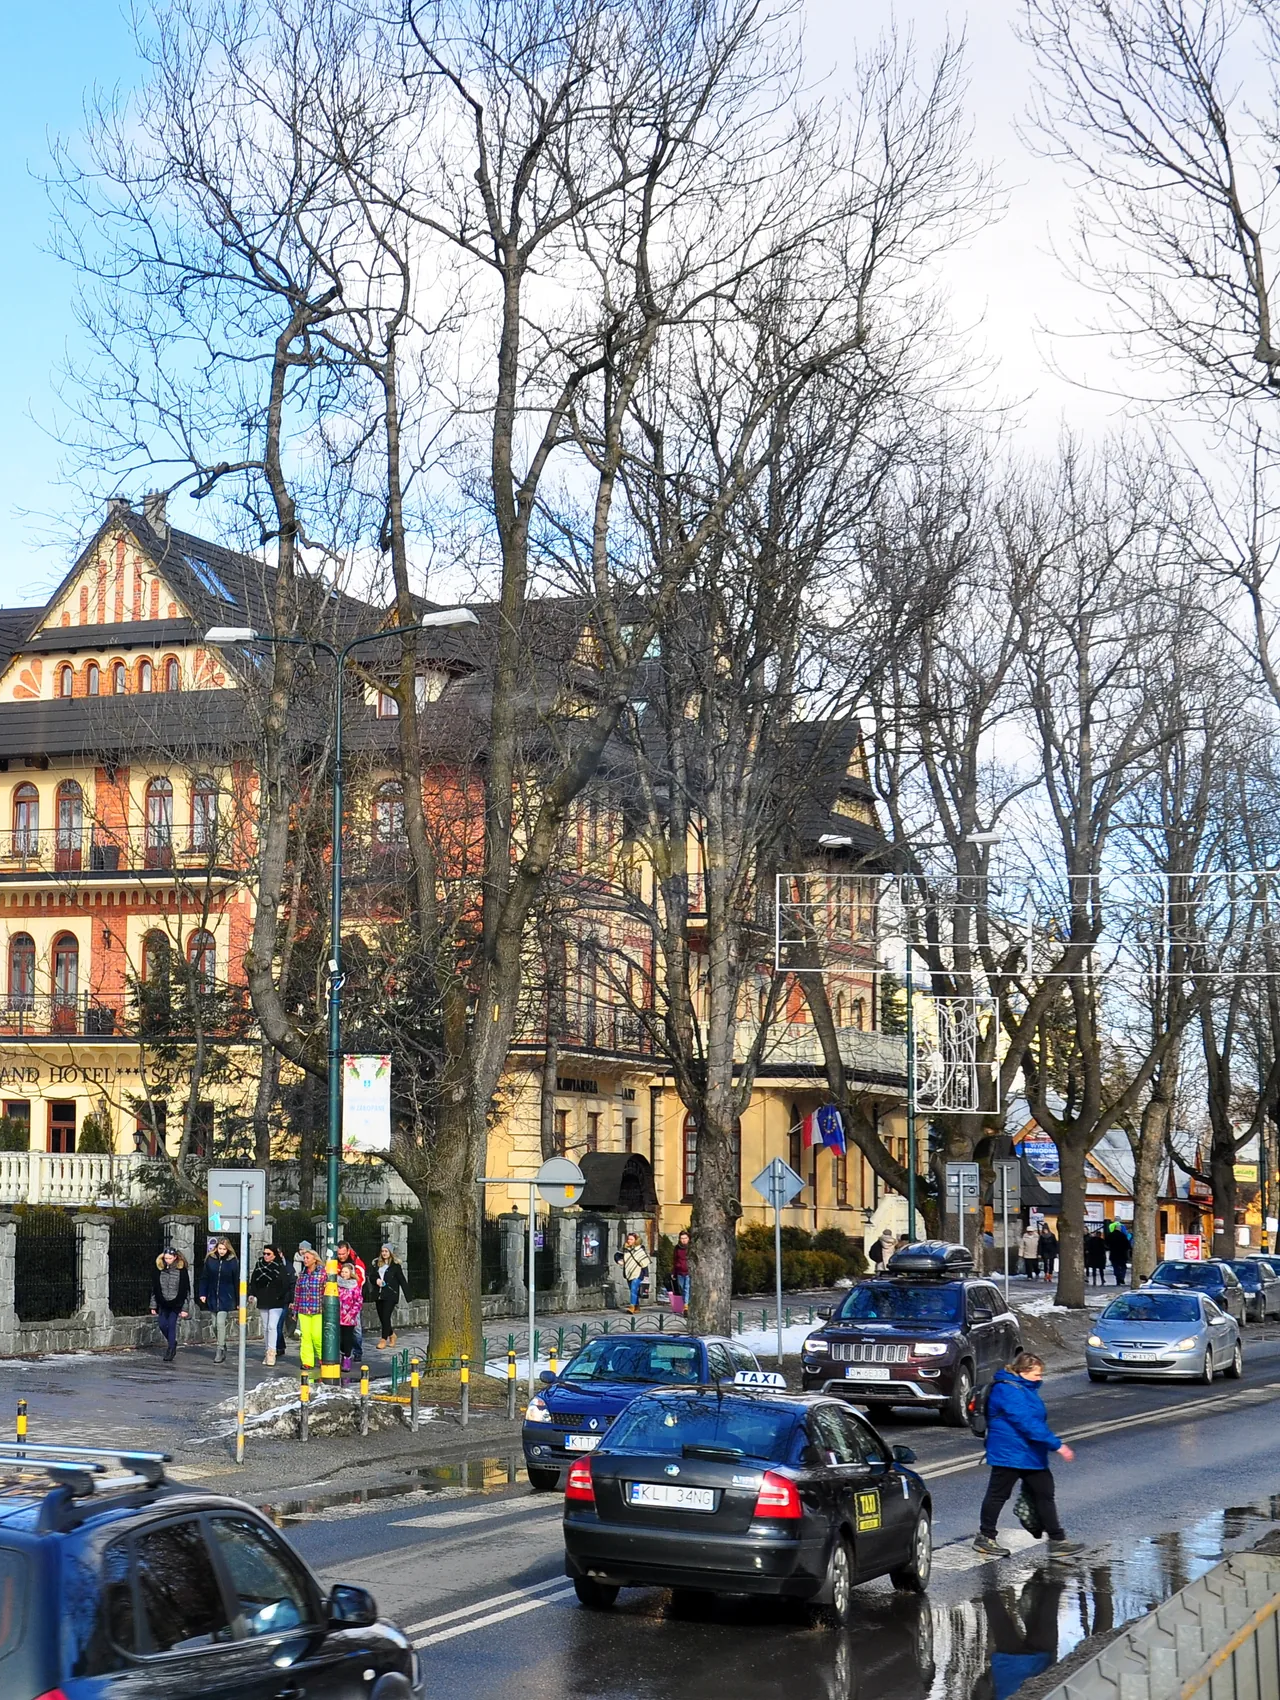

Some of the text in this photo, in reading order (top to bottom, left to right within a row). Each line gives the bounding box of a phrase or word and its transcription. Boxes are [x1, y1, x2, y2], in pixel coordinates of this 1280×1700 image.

[49, 1066, 114, 1084] HOTEL
[740, 1372, 777, 1384] TAXI
[571, 1436, 591, 1447] KTT
[641, 1486, 712, 1505] KLI 34NG
[859, 1494, 876, 1514] TAXI
